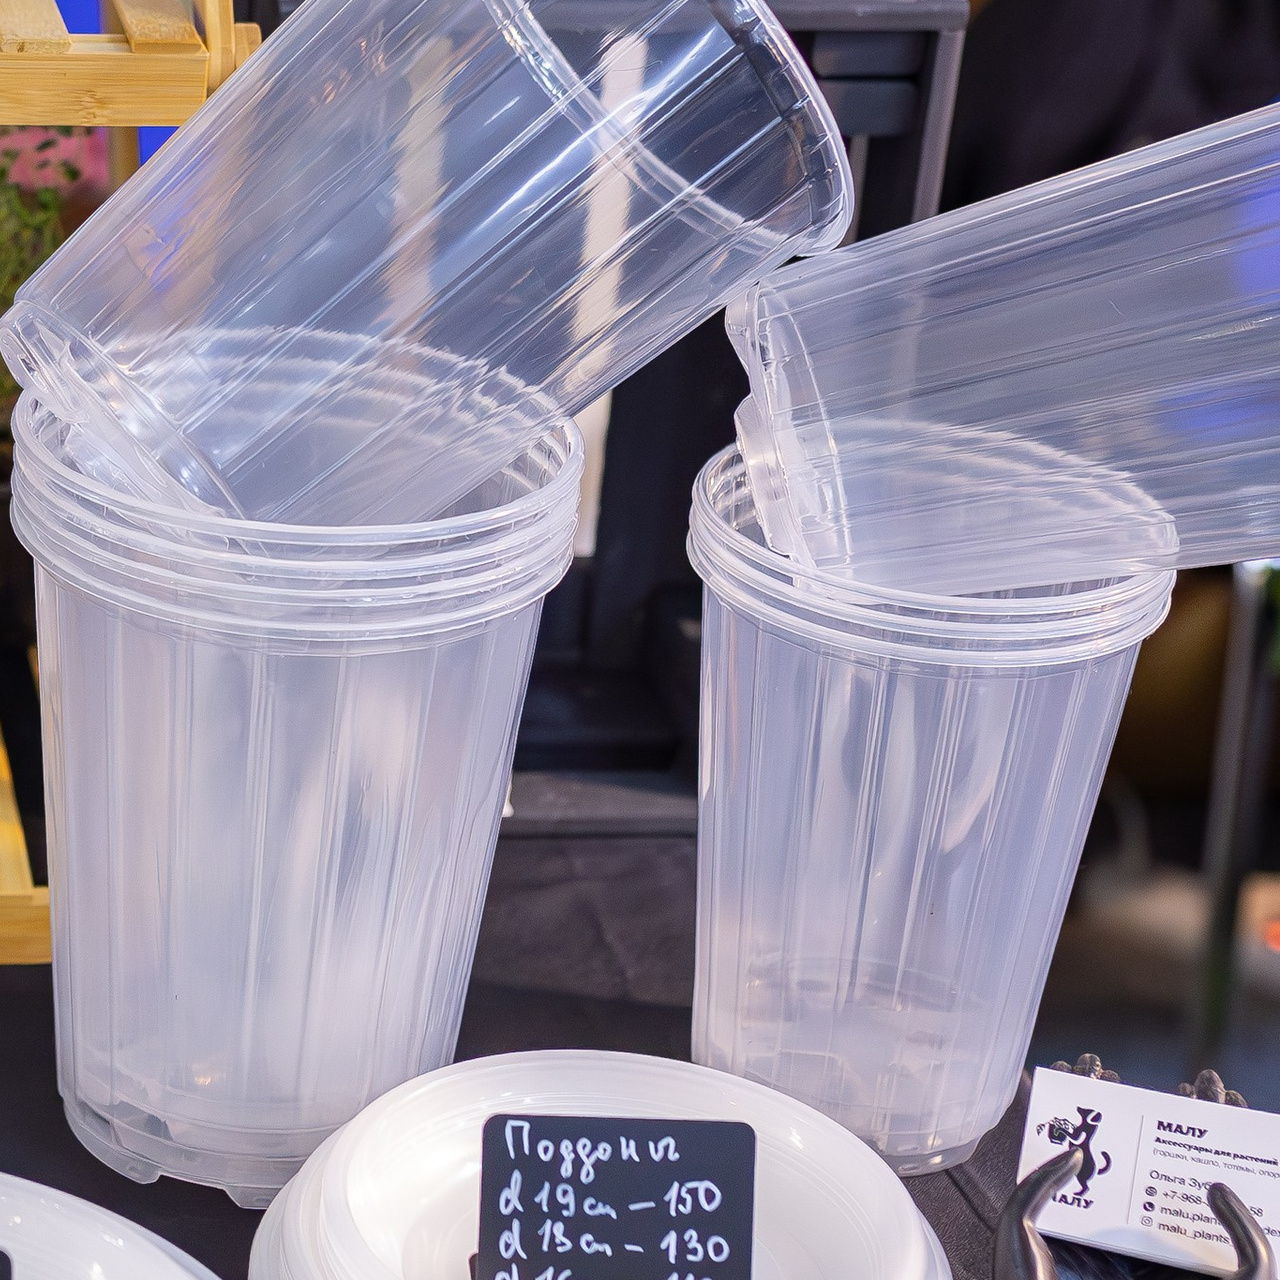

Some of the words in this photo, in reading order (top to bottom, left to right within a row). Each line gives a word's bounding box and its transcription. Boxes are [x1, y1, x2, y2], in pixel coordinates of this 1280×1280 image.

[1156, 1120, 1209, 1138] МАЛУ
[1155, 1136, 1213, 1154] Аксессуары
[1213, 1149, 1232, 1158] для
[1232, 1151, 1279, 1167] растений
[1149, 1169, 1186, 1186] Ольга
[663, 1180, 722, 1217] 150
[660, 1229, 730, 1264] 130
